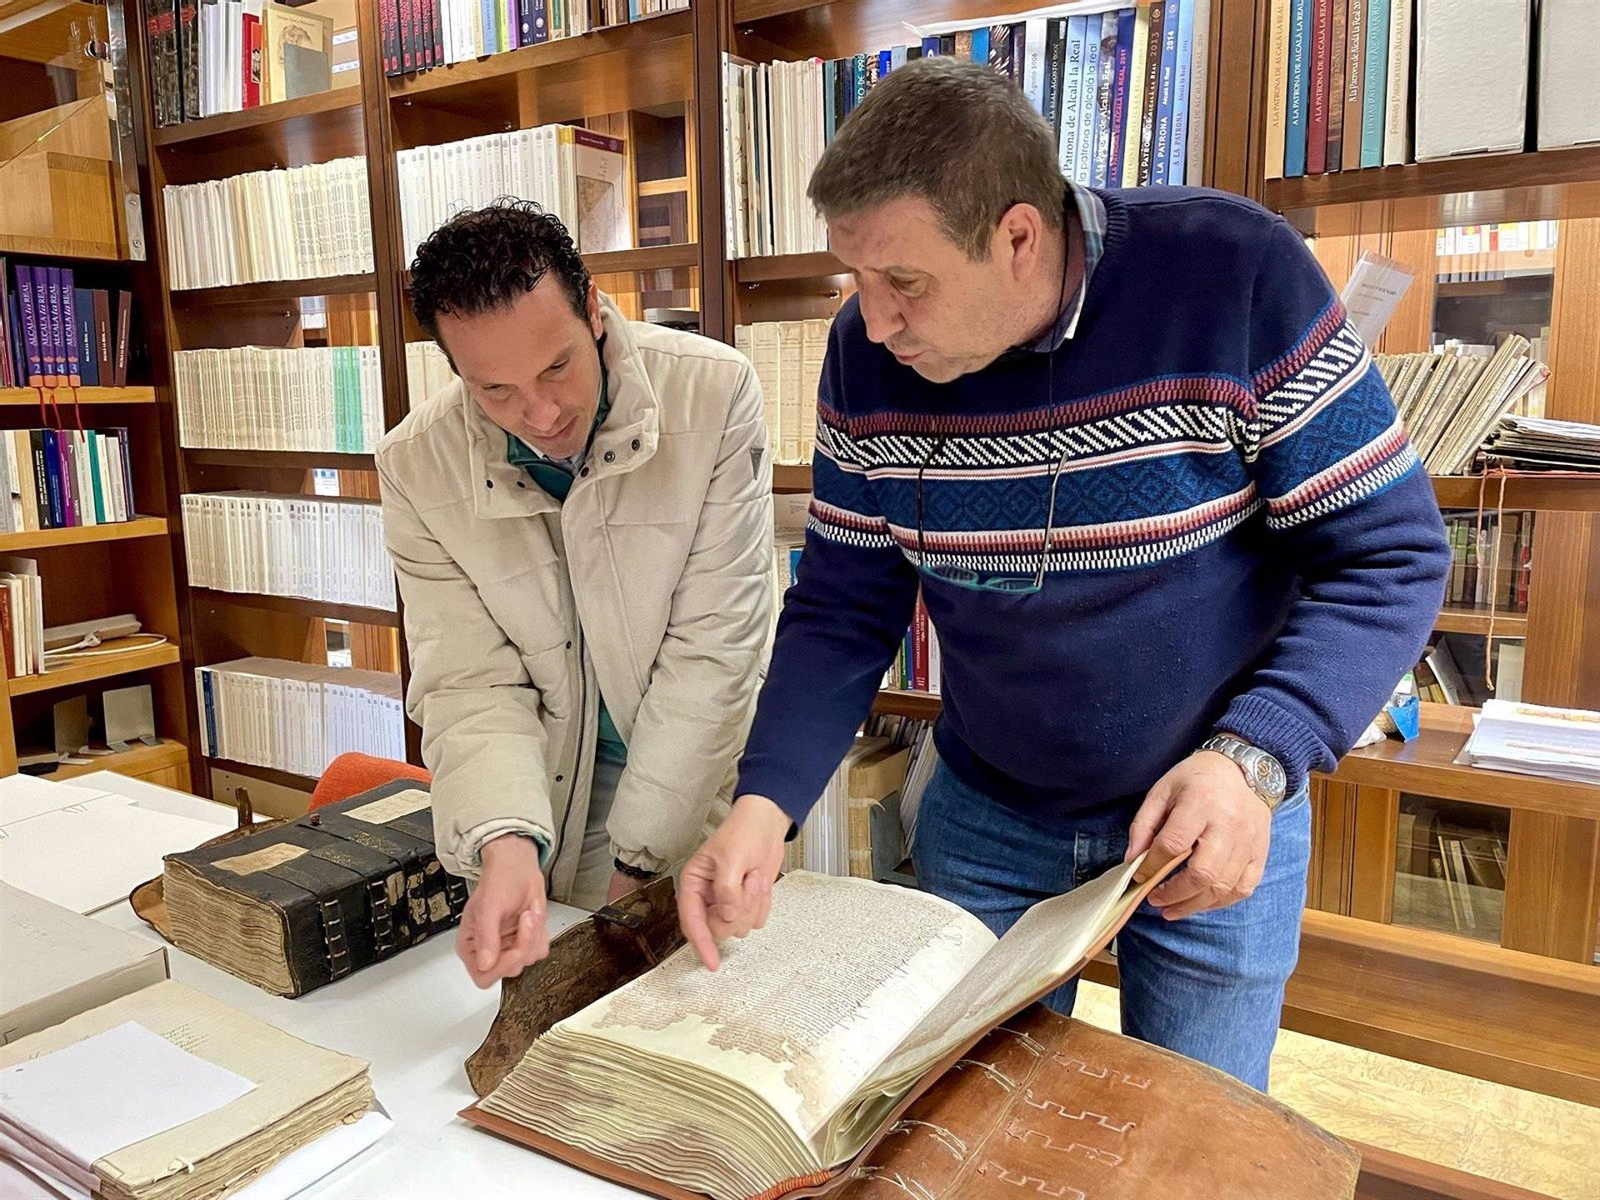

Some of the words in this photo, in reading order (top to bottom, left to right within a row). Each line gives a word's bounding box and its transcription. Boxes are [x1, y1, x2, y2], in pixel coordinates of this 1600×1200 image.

[1319, 17, 1326, 28] LA
[1352, 10, 1361, 26] Real
[1276, 24, 1283, 35] LA
[1296, 21, 1303, 32] LA
[1352, 25, 1360, 33] la
[1166, 30, 1175, 51] 2014
[1317, 28, 1326, 59] ALCALÁ
[1350, 33, 1360, 53] Alcalá
[1070, 40, 1081, 63] Real
[1087, 43, 1098, 63] real
[1294, 32, 1303, 62] ALCALÁ
[1350, 54, 1358, 62] de
[1068, 67, 1079, 76] la
[1086, 66, 1095, 75] la
[1101, 61, 1111, 80] Real
[1275, 66, 1281, 76] DE
[1294, 63, 1301, 73] DE
[1317, 60, 1324, 71] DE
[1050, 61, 1058, 89] AGOSTO
[1163, 66, 1171, 80] Real
[1349, 62, 1359, 89] Patrona
[857, 75, 865, 85] DE
[1030, 71, 1038, 96] Agosto
[1101, 82, 1109, 90] la
[1084, 77, 1095, 110] alcalá
[1117, 87, 1124, 96] LA
[1273, 76, 1281, 111] PATRONA
[1292, 74, 1301, 109] PATRONA
[1315, 71, 1324, 105] PATRONA
[1066, 78, 1079, 113] Alcala
[1161, 87, 1169, 106] Alcalá
[1099, 91, 1108, 117] Alcalá
[1113, 97, 1122, 123] ALCALÁ
[1142, 169, 1148, 179] LA
[1150, 31, 1159, 57] 2013
[1194, 110, 1200, 119] DE
[1273, 111, 1279, 122] LA
[1292, 109, 1299, 119] LA
[1315, 105, 1322, 116] LA
[1066, 115, 1076, 128] de
[1083, 113, 1091, 127] de
[1099, 119, 1106, 129] de
[1114, 124, 1120, 133] DE
[1174, 112, 1183, 145] PATRONA
[1157, 116, 1168, 158] PATRONA
[1193, 120, 1201, 153] PATRONA
[1063, 131, 1075, 171] Patrona
[1080, 129, 1091, 170] patrona
[1112, 134, 1120, 166] PATRONA
[1173, 148, 1180, 158] LA
[1193, 153, 1199, 162] LA
[1112, 166, 1117, 176] LA
[1156, 162, 1164, 174] LA
[1078, 172, 1087, 182] la
[1095, 173, 1103, 181] A
[22, 281, 31, 303] REAL
[37, 283, 46, 304] REAL
[49, 283, 57, 304] REAL
[62, 284, 70, 305] REAL
[25, 303, 32, 314] la
[39, 304, 47, 315] la
[51, 304, 58, 315] la
[63, 305, 71, 315] la
[34, 363, 41, 374] 2
[47, 363, 52, 374] 1
[56, 363, 65, 374] 4
[70, 363, 77, 374] 3
[68, 444, 74, 454] 7
